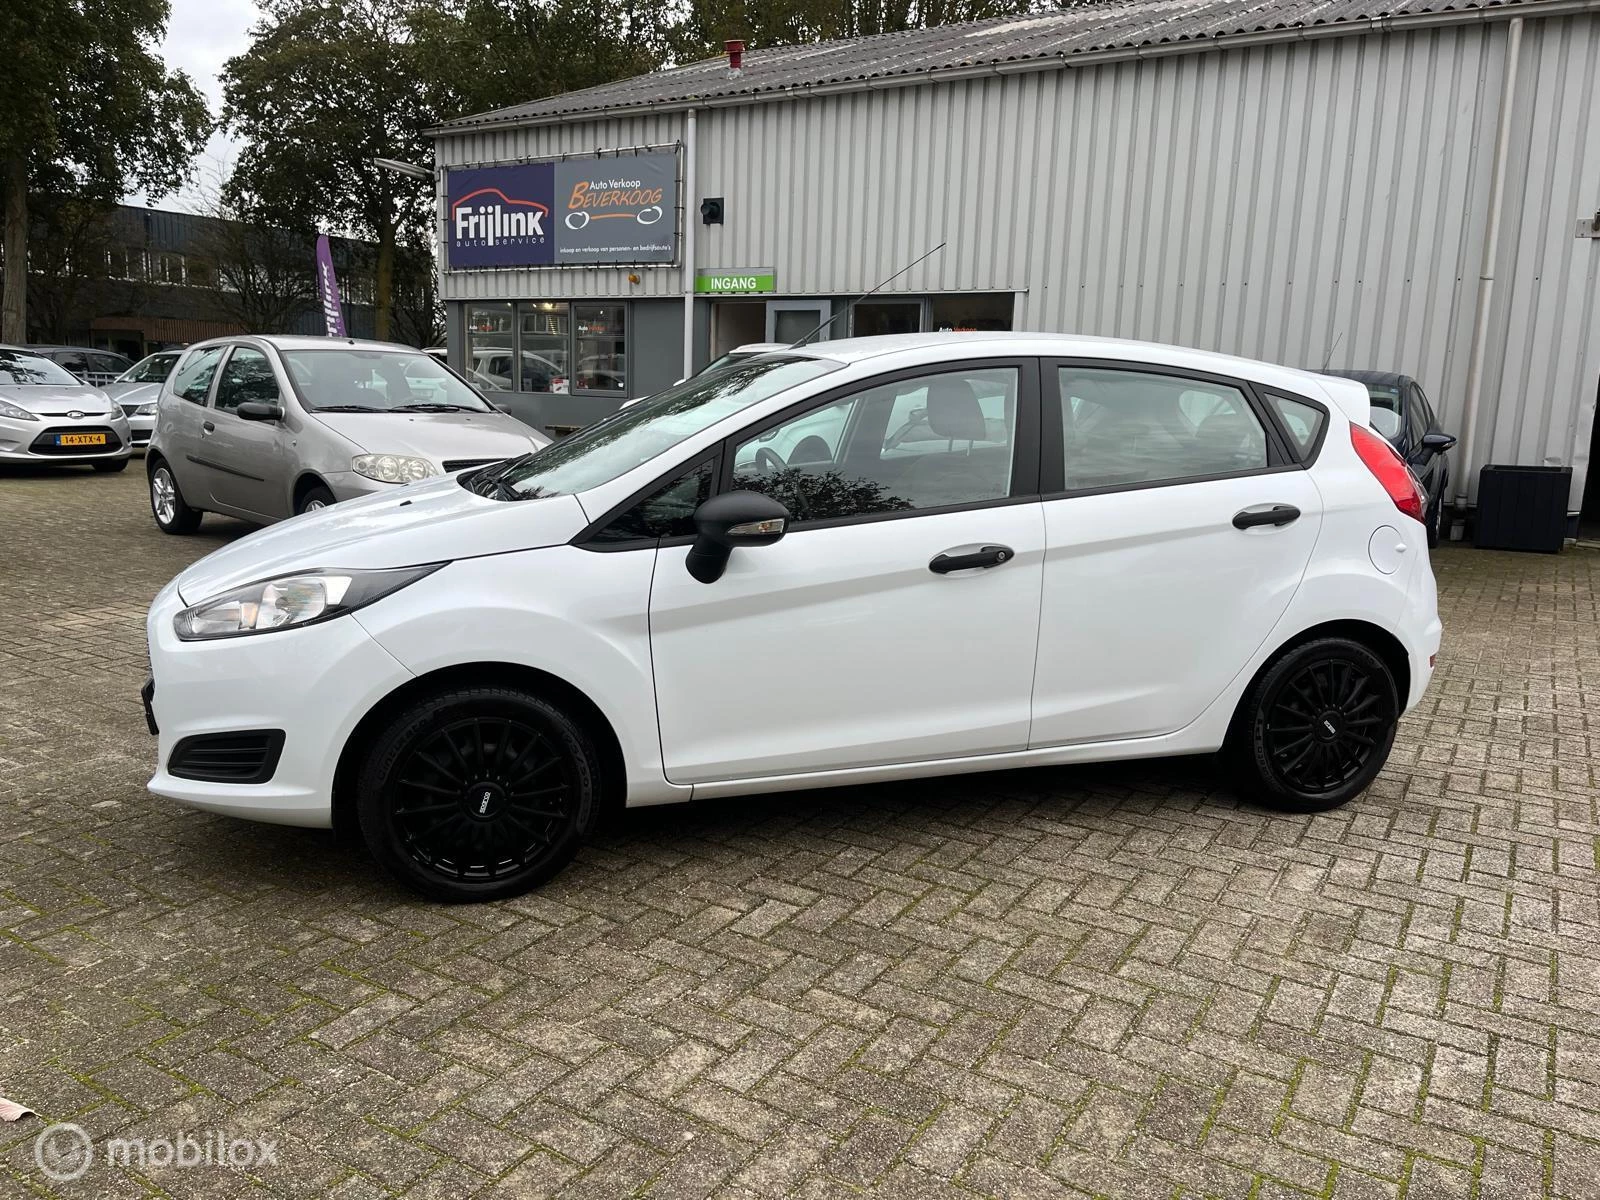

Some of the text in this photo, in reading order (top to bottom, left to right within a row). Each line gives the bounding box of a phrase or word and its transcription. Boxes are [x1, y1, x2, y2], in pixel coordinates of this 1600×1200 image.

[589, 178, 641, 190] Auto Verkoop
[568, 181, 663, 209] BEVERKOOG
[455, 205, 545, 246] Frijlink
[582, 245, 600, 253] verkoop
[711, 277, 757, 290] INGANG
[65, 435, 102, 444] 14-XTX-4
